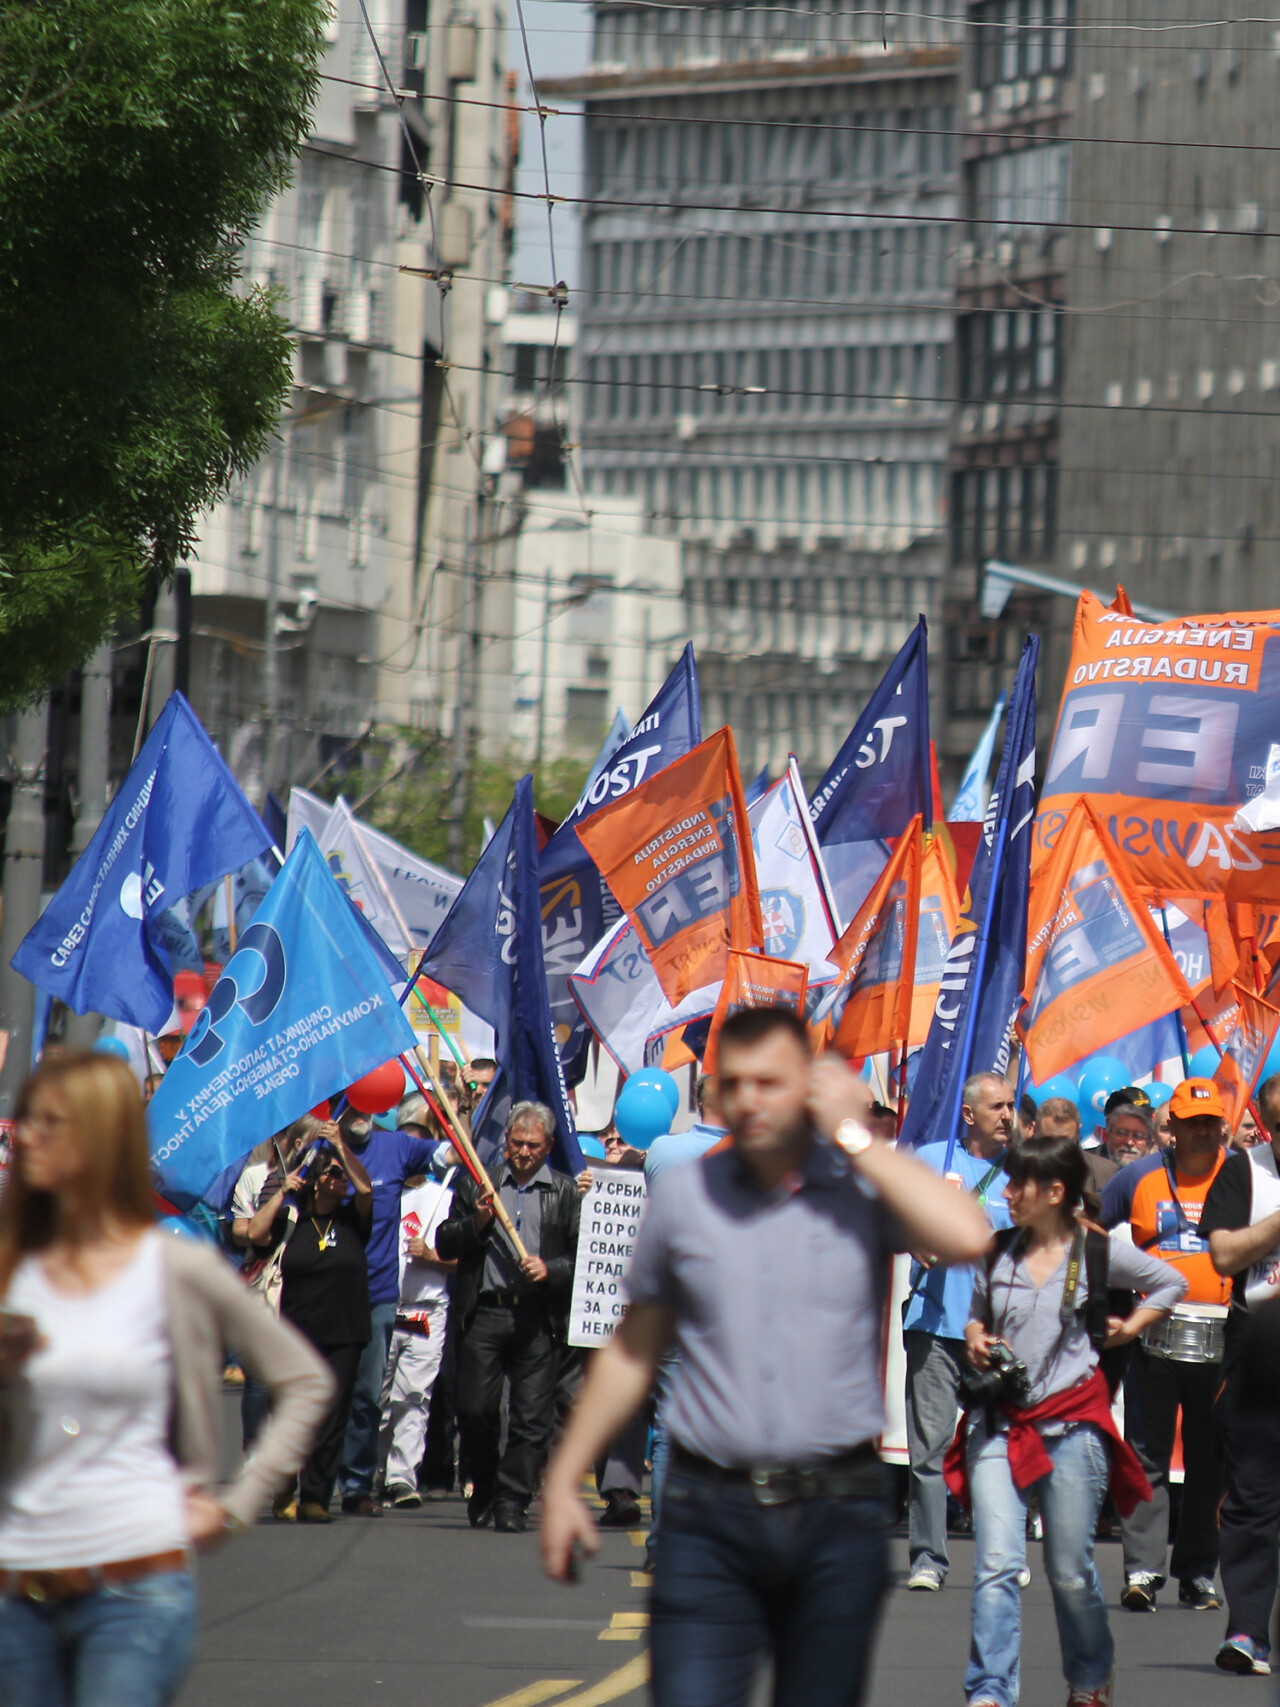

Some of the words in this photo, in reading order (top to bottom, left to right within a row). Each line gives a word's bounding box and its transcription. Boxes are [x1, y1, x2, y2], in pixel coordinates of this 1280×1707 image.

[51, 923, 86, 967] САВЕЗ
[595, 1181, 603, 1194] У
[594, 1201, 641, 1219] СВАКИ
[590, 1241, 633, 1258] СВАКЕ
[587, 1261, 623, 1278] ГРАД
[586, 1281, 618, 1296] КАО
[584, 1300, 601, 1316] ЗА
